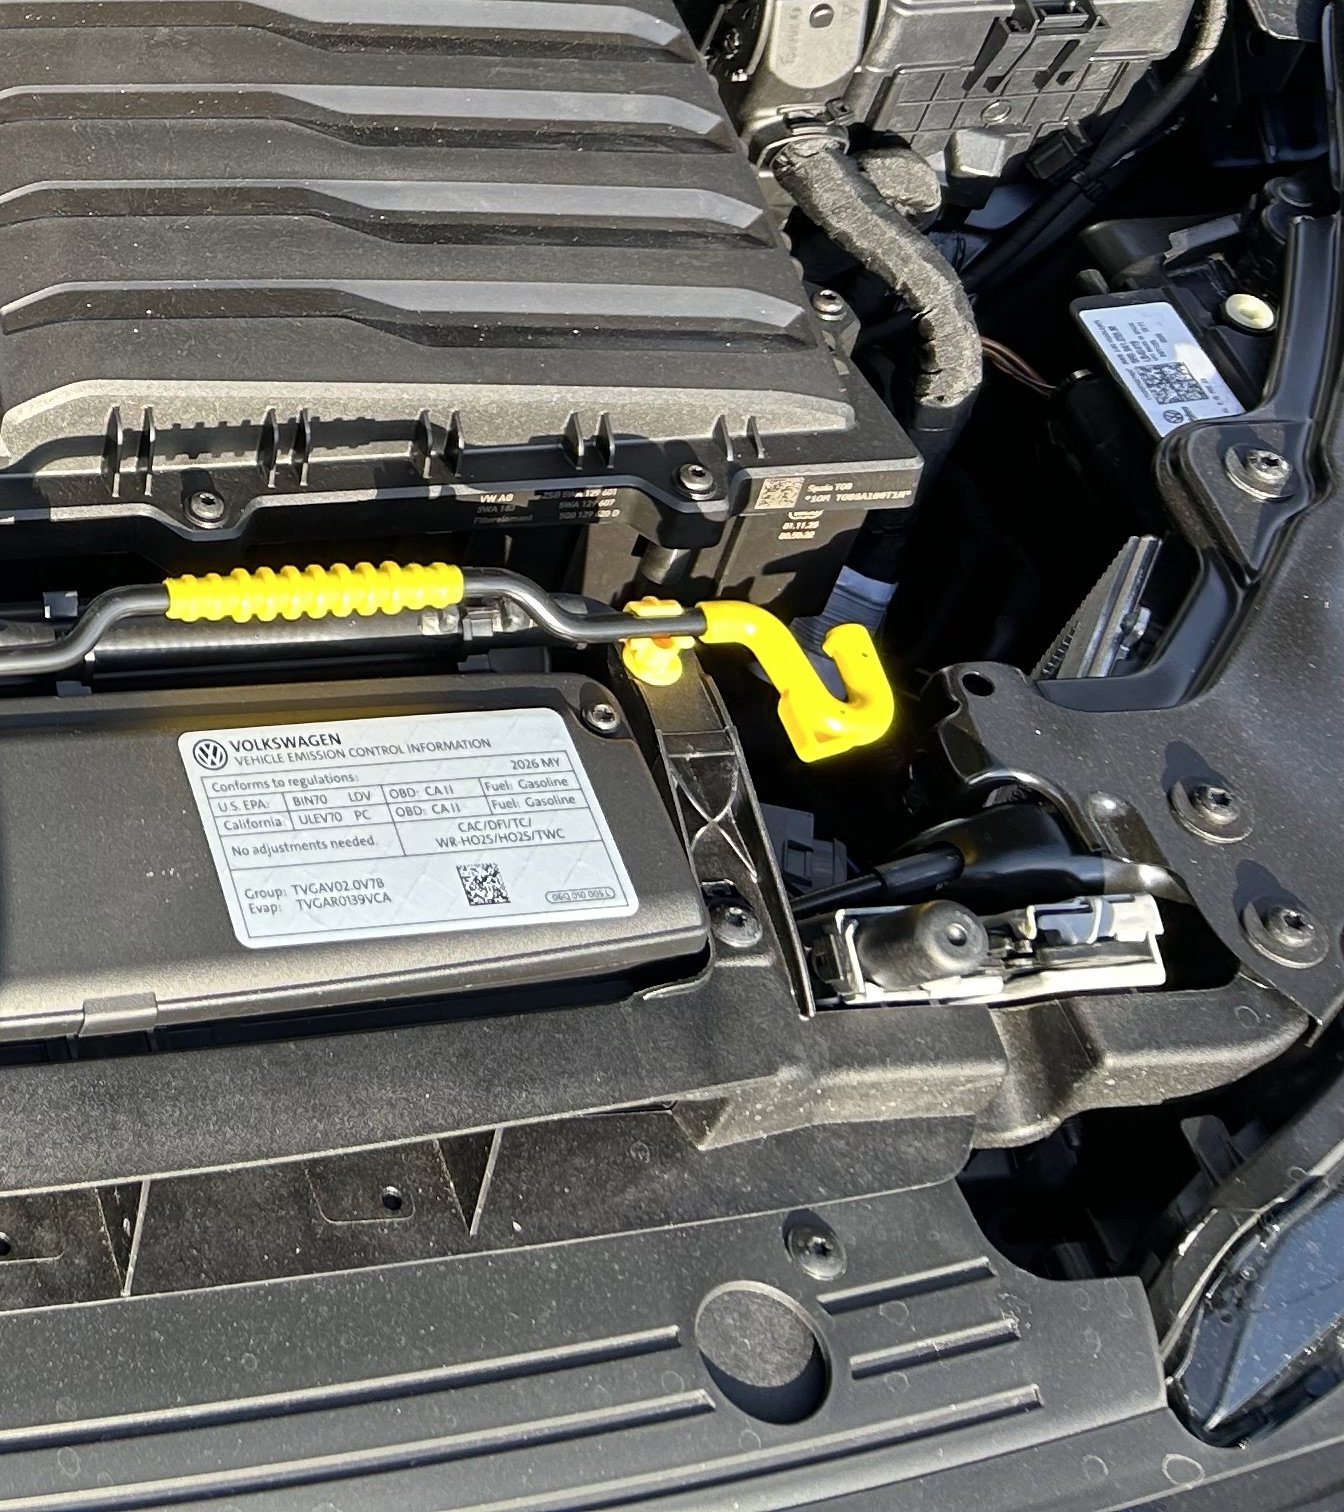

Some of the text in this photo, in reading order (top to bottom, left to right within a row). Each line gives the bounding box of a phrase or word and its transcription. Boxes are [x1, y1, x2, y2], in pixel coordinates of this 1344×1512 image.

[229, 733, 342, 753] VOLKSWAGEN
[234, 739, 491, 766] VEHICLE EMISSION CONTROL INFORMATION
[511, 757, 560, 770] 2026 MY
[212, 773, 359, 793] Conforms to regulations:
[293, 794, 328, 807] BIN70
[348, 791, 371, 802] LDV
[424, 786, 441, 796] CA
[518, 777, 569, 789] Gasoline
[299, 812, 343, 825] ULEV70
[354, 809, 371, 821] PC
[432, 804, 449, 815] CA
[525, 795, 576, 807] Gasoline
[232, 846, 249, 857] No
[253, 840, 328, 857] adjustments
[245, 889, 287, 900] Group:
[250, 904, 282, 915] Evap:
